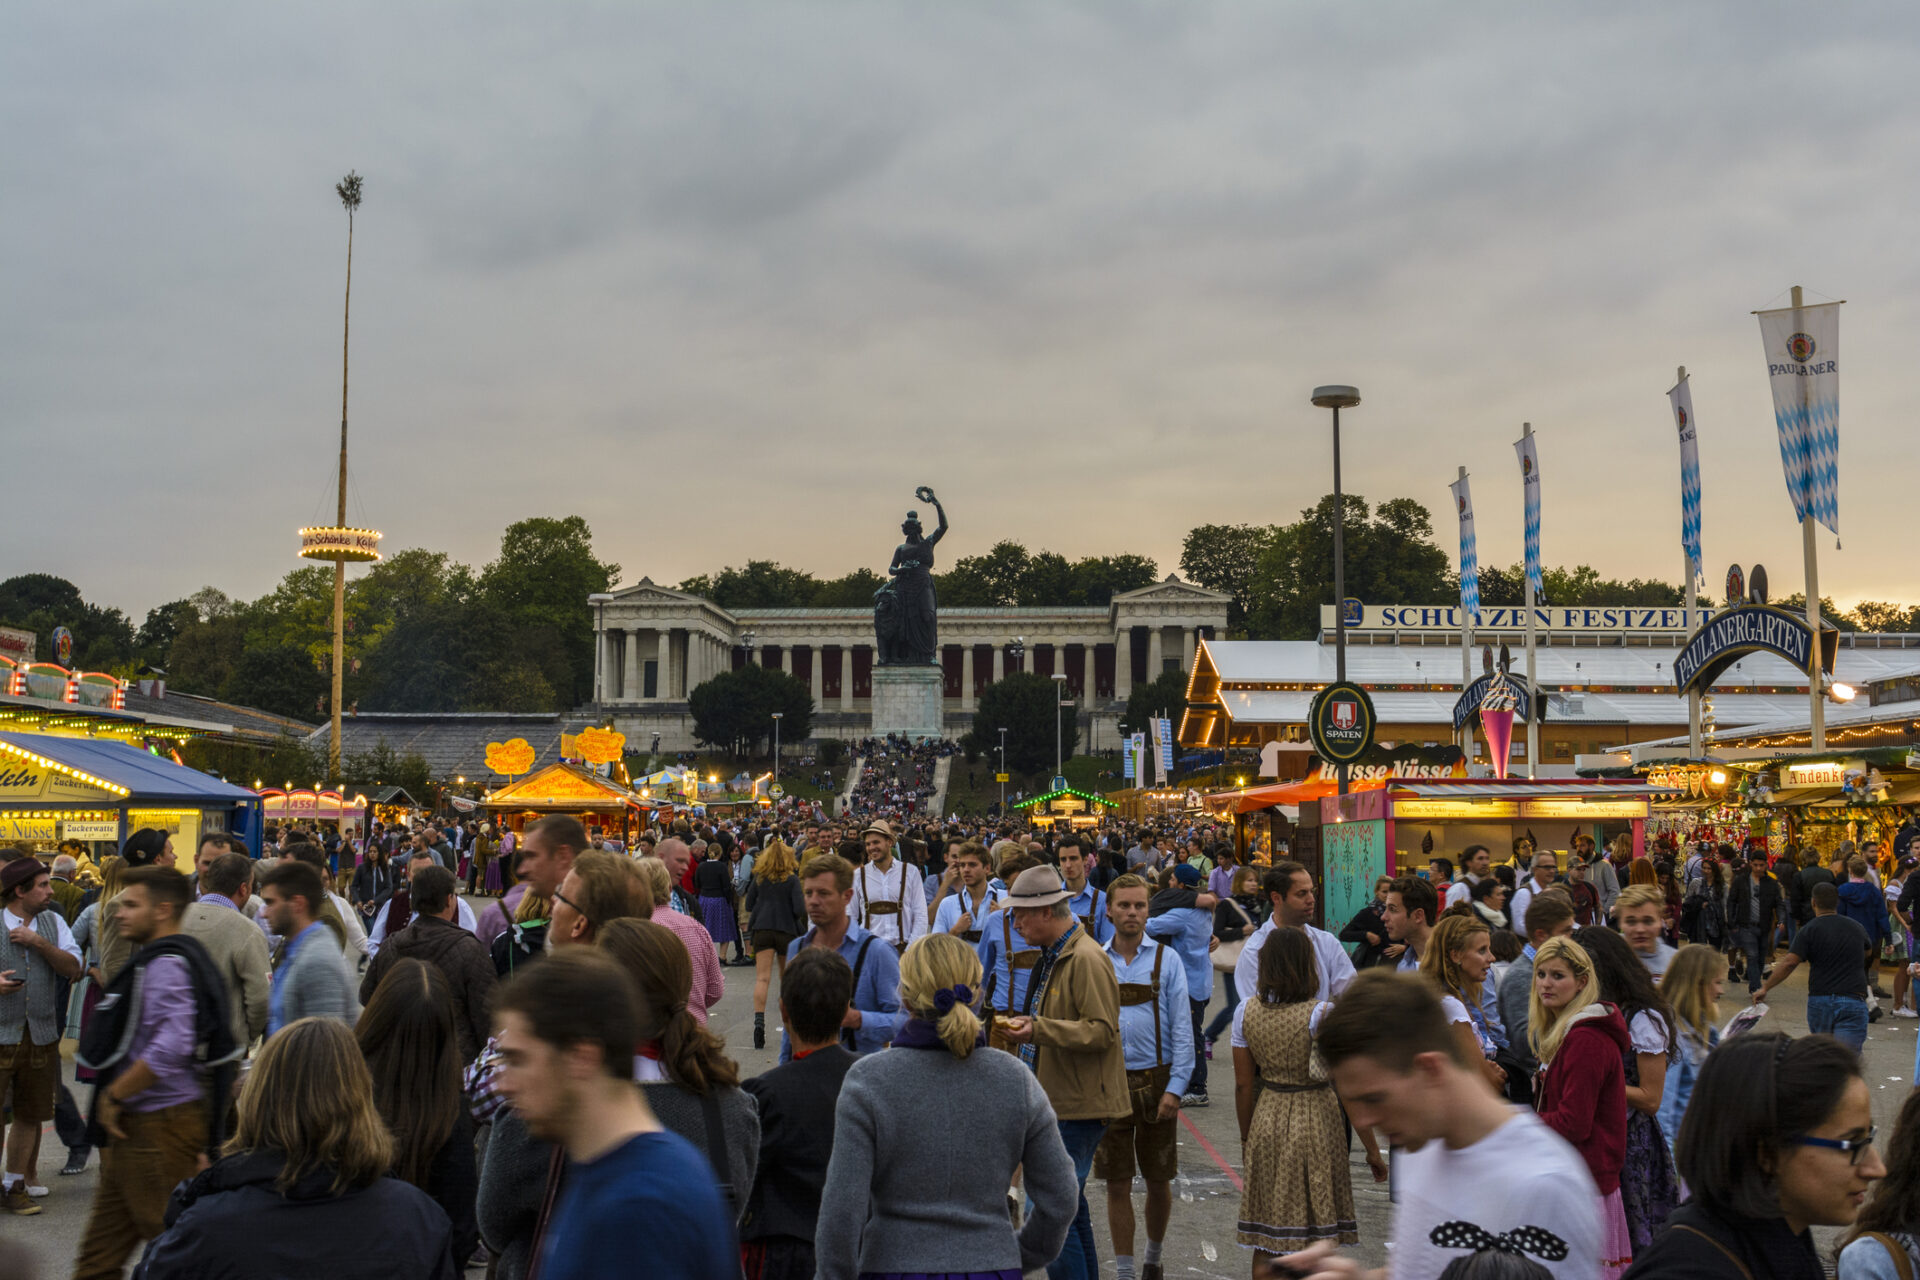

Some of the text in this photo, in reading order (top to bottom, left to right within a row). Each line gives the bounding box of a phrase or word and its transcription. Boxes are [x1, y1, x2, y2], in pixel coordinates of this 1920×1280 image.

[1769, 361, 1837, 377] PAULANER
[1678, 612, 1808, 688] PAULANERGARTEN
[1326, 730, 1362, 739] SPATEN
[1391, 758, 1453, 779] Nüsse
[1789, 769, 1845, 785] Andenke
[12, 820, 53, 839] Nüsse
[67, 824, 114, 832] Zuckerwatte
